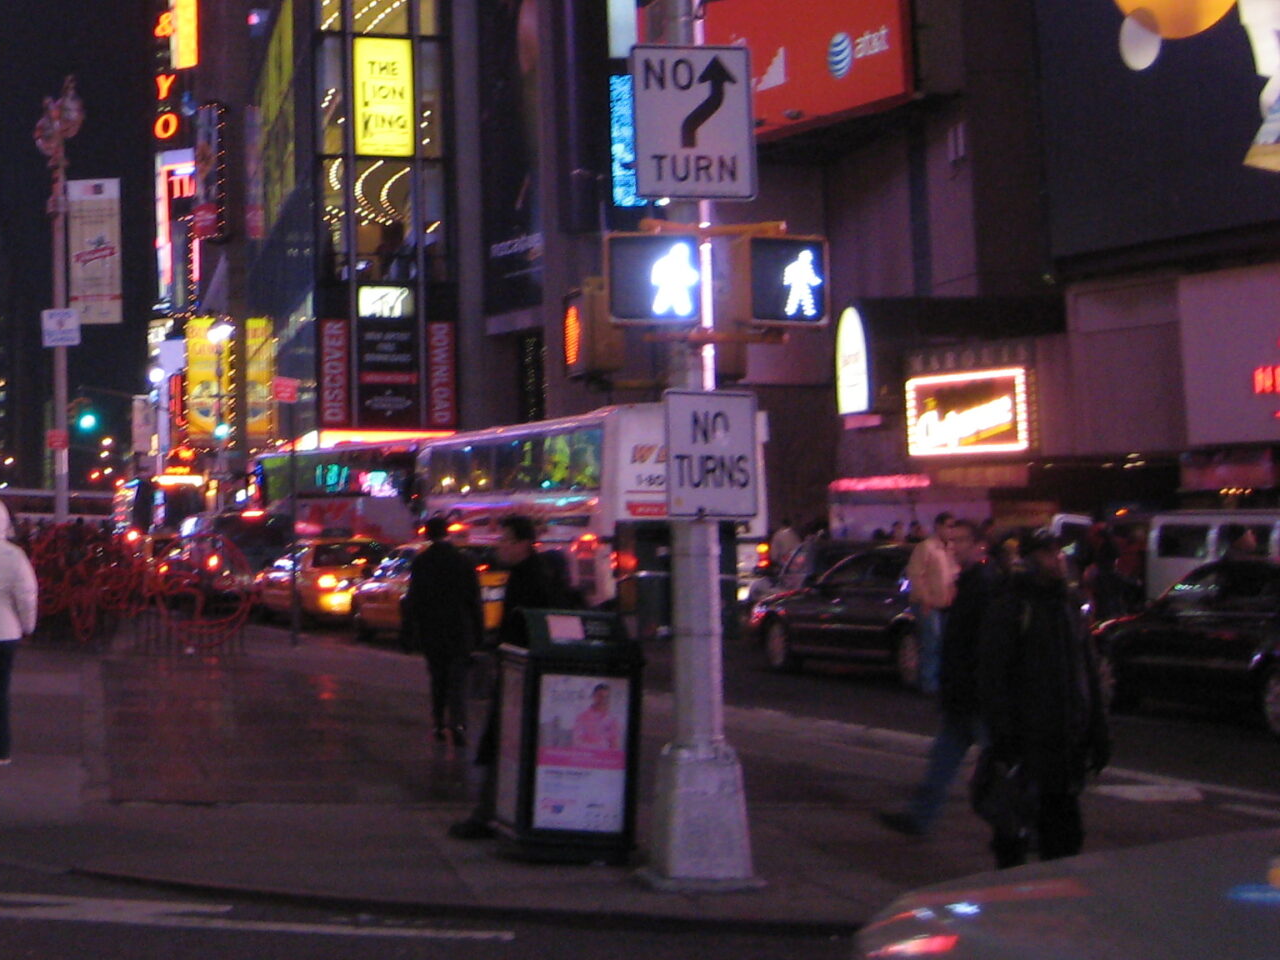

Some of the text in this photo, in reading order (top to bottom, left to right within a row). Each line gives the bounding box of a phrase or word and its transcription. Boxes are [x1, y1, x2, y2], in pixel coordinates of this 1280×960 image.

[154, 12, 176, 38] &
[854, 24, 890, 59] at&t
[368, 60, 399, 76] THE
[643, 58, 694, 91] NO
[361, 81, 406, 108] LION
[361, 111, 408, 139] KING
[651, 154, 737, 183] TURN
[322, 320, 346, 422] DISCOVER
[430, 323, 452, 424] DOWNLOAD
[691, 410, 731, 445] NO
[674, 454, 750, 489] TURNS
